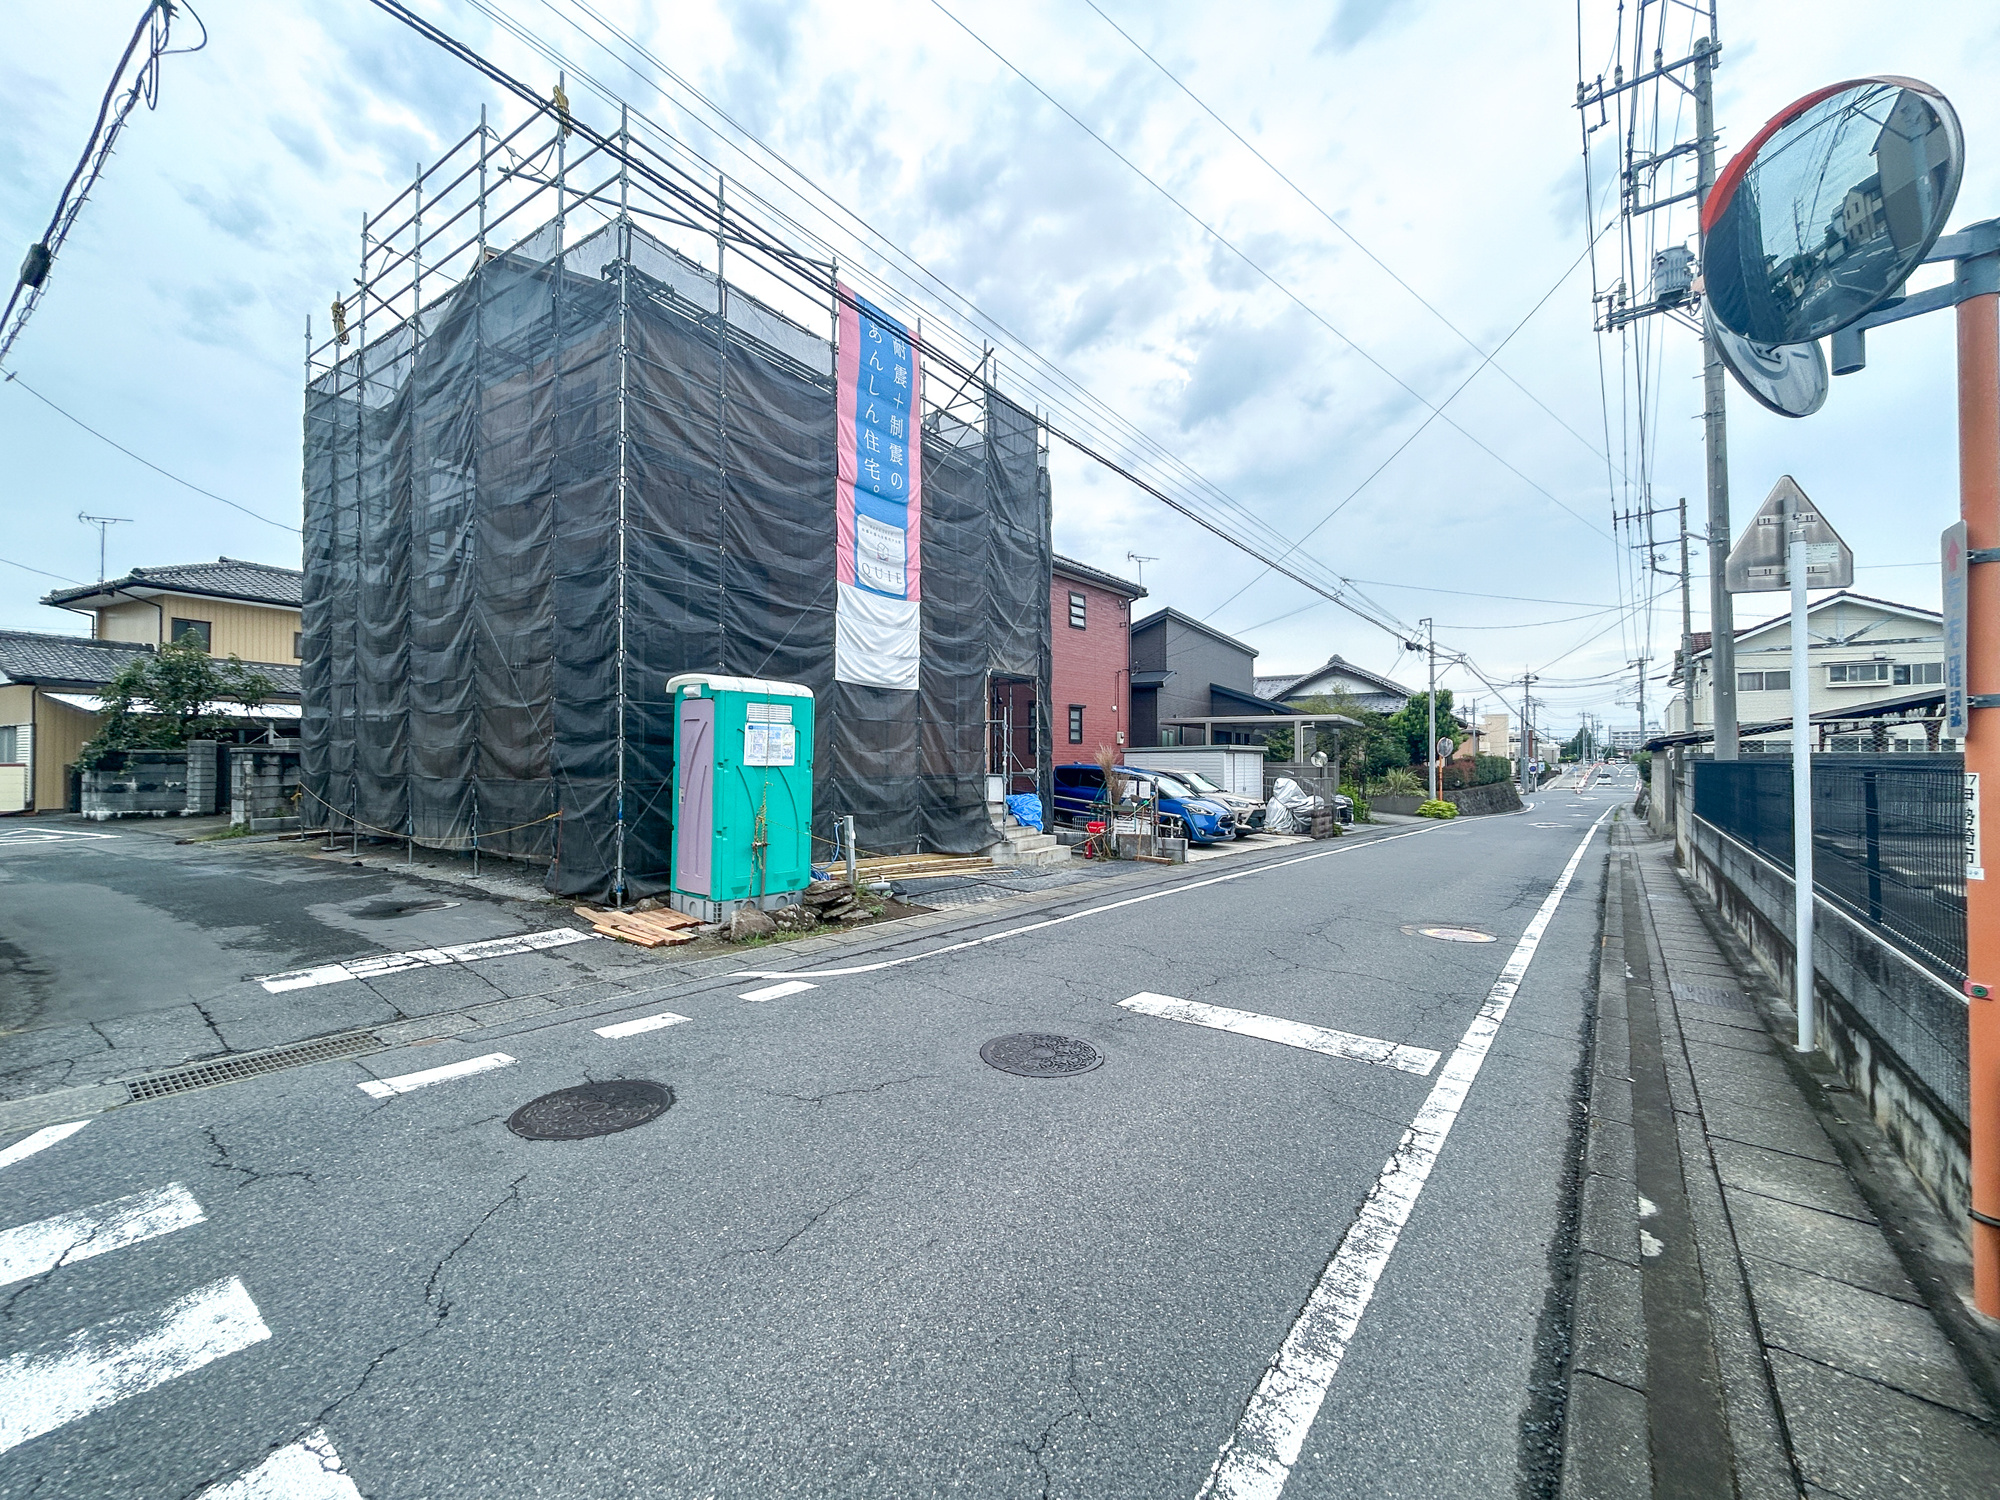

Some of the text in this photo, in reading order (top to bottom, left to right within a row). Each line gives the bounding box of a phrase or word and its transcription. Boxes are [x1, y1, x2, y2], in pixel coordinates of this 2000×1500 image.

[863, 323, 884, 493] あんしん住宅。
[862, 562, 903, 585] QUIE
